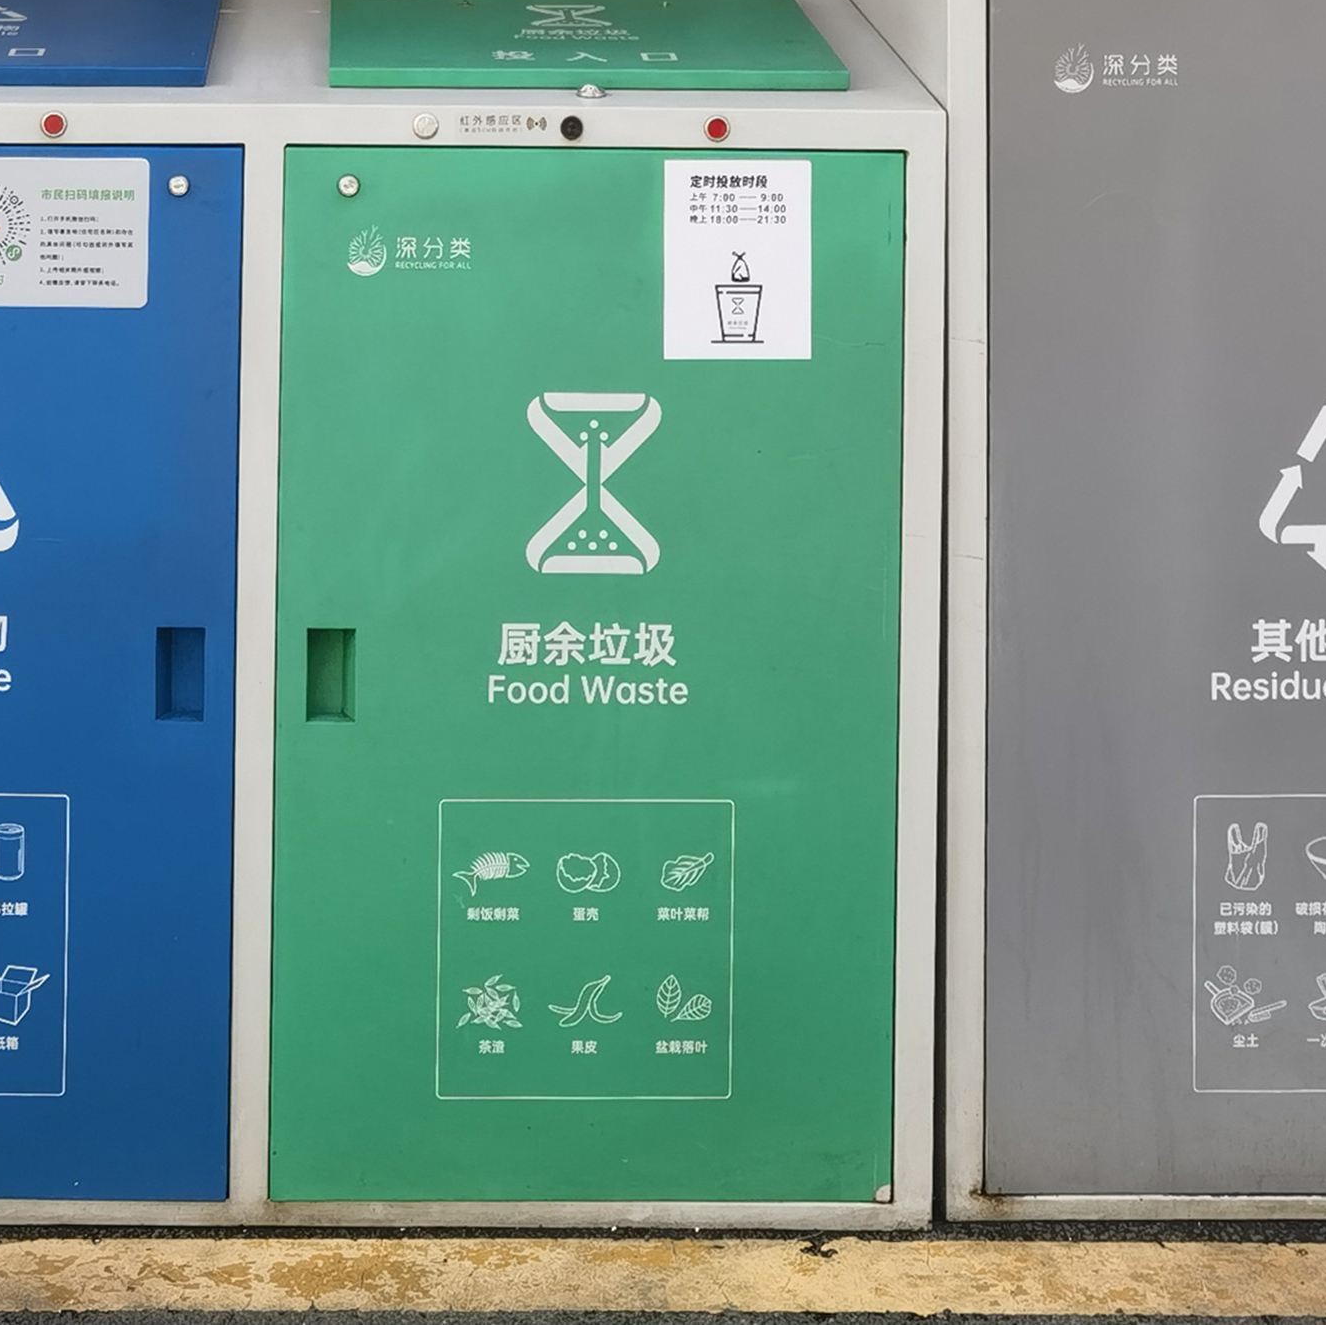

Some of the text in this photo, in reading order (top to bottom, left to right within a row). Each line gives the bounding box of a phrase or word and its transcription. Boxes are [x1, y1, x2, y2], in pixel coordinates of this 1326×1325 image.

[1103, 54, 1177, 75] 深分类
[1103, 78, 1142, 86] RECYCLING
[1142, 78, 1160, 86] FOR
[458, 114, 523, 127] 红外感应区
[690, 175, 767, 188] 定时投放时段
[41, 189, 134, 201] 市民扫码填报说明
[690, 193, 706, 201] 上午
[713, 193, 735, 202] 7:00
[761, 193, 783, 202] 9:00
[690, 215, 706, 223] 晚上
[396, 237, 470, 259] 深分类
[395, 261, 435, 270] RECYCLING
[498, 621, 676, 666] 厨余垃圾
[489, 674, 688, 704] Food Waste
[466, 906, 519, 921] 剩饭剩菜
[573, 907, 598, 921] 蛋壳
[658, 907, 709, 921] 菜叶菜帮
[1220, 902, 1271, 916] 已污染的
[479, 1040, 505, 1054] 茶渣
[571, 1040, 597, 1054] 果皮
[656, 1040, 707, 1054] 盆栽落叶
[1233, 1033, 1259, 1047] 尘土
